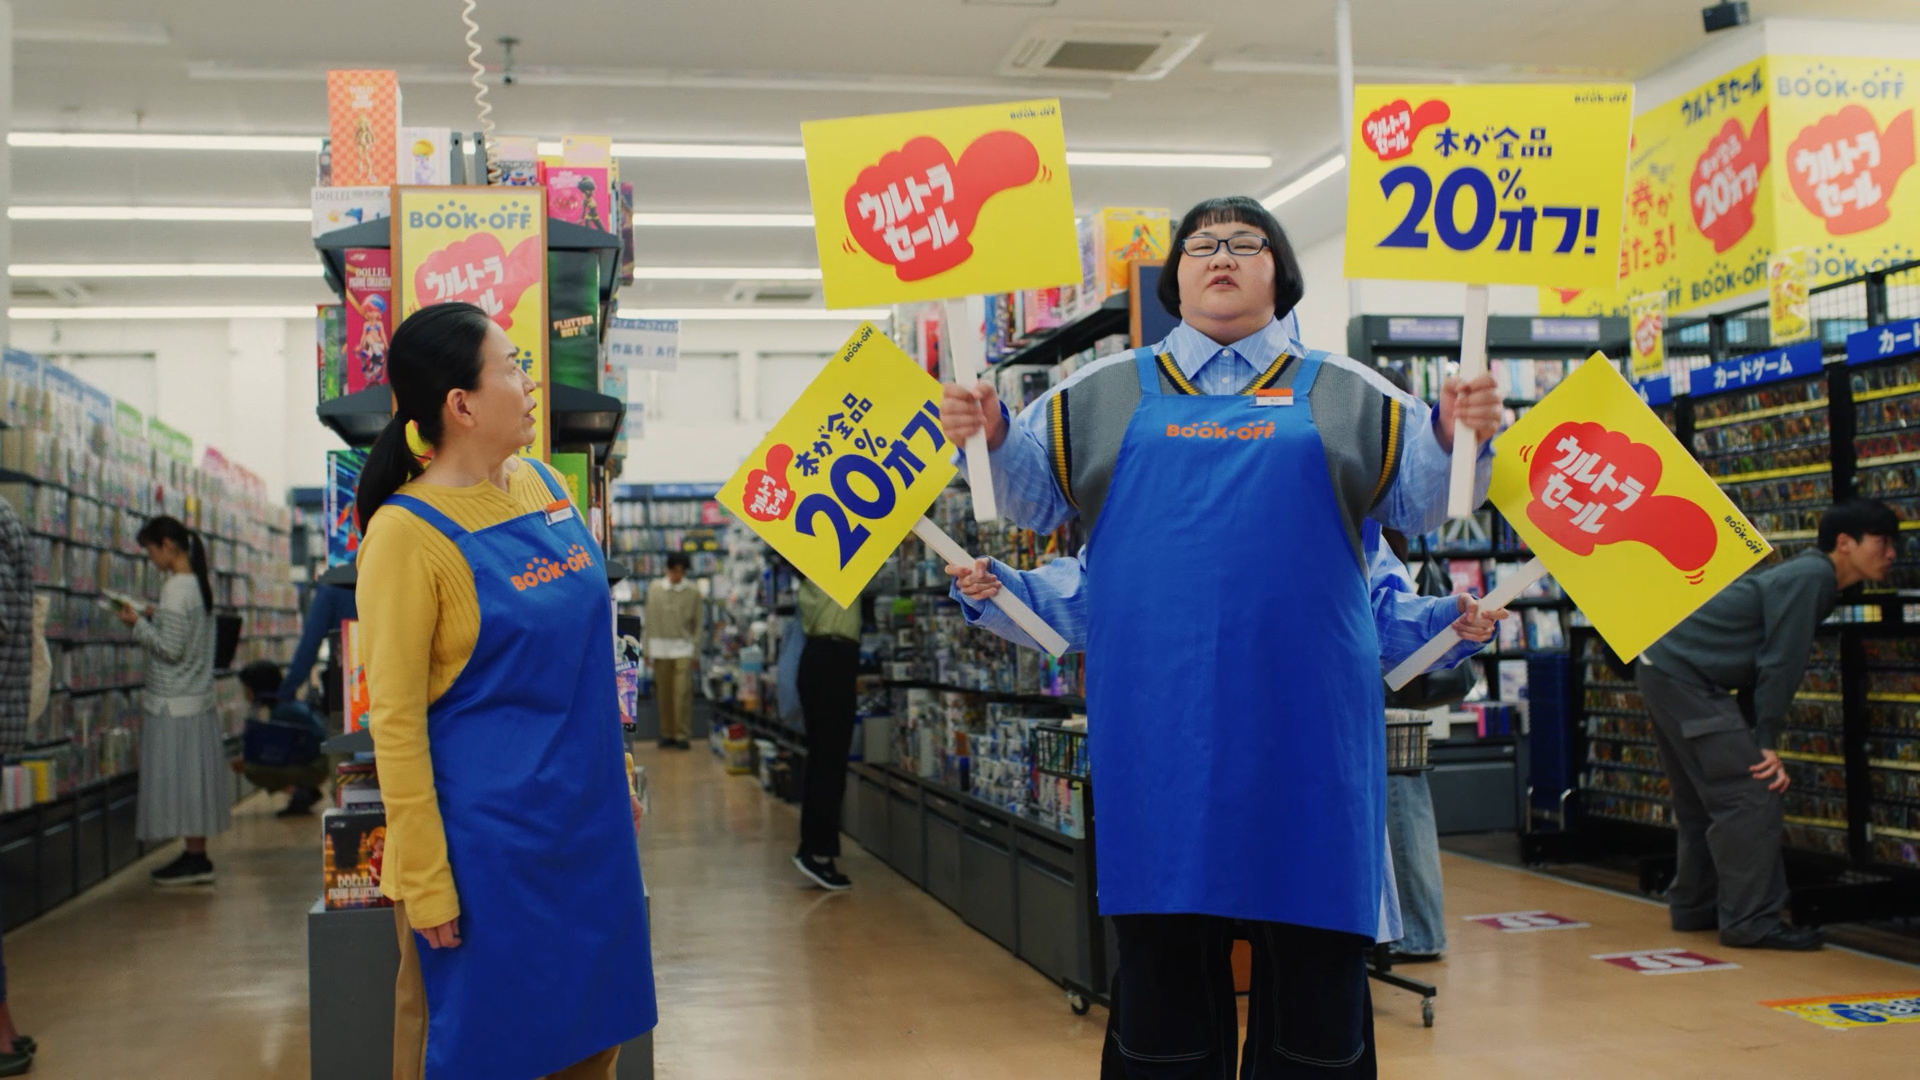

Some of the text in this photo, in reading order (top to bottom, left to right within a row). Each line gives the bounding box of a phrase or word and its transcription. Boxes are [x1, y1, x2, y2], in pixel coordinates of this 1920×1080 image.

[1682, 66, 1763, 126] ウルトラセール
[1367, 110, 1410, 140] ウルトラ
[1375, 129, 1410, 155] セール
[1434, 126, 1553, 158] 本が全品
[1794, 130, 1881, 186] ウルトラ
[857, 163, 954, 232] ウルトラ
[1815, 168, 1882, 217] セール
[882, 206, 959, 262] セール
[425, 255, 504, 301] ウルトラ
[553, 314, 595, 331] FLUTTER
[1713, 352, 1794, 390] カードゲーム
[794, 392, 873, 477] 本が全品
[750, 474, 776, 514] ウルトラ
[1551, 434, 1646, 512] ウルトラ
[765, 487, 788, 516] セール
[1541, 472, 1608, 534] セール
